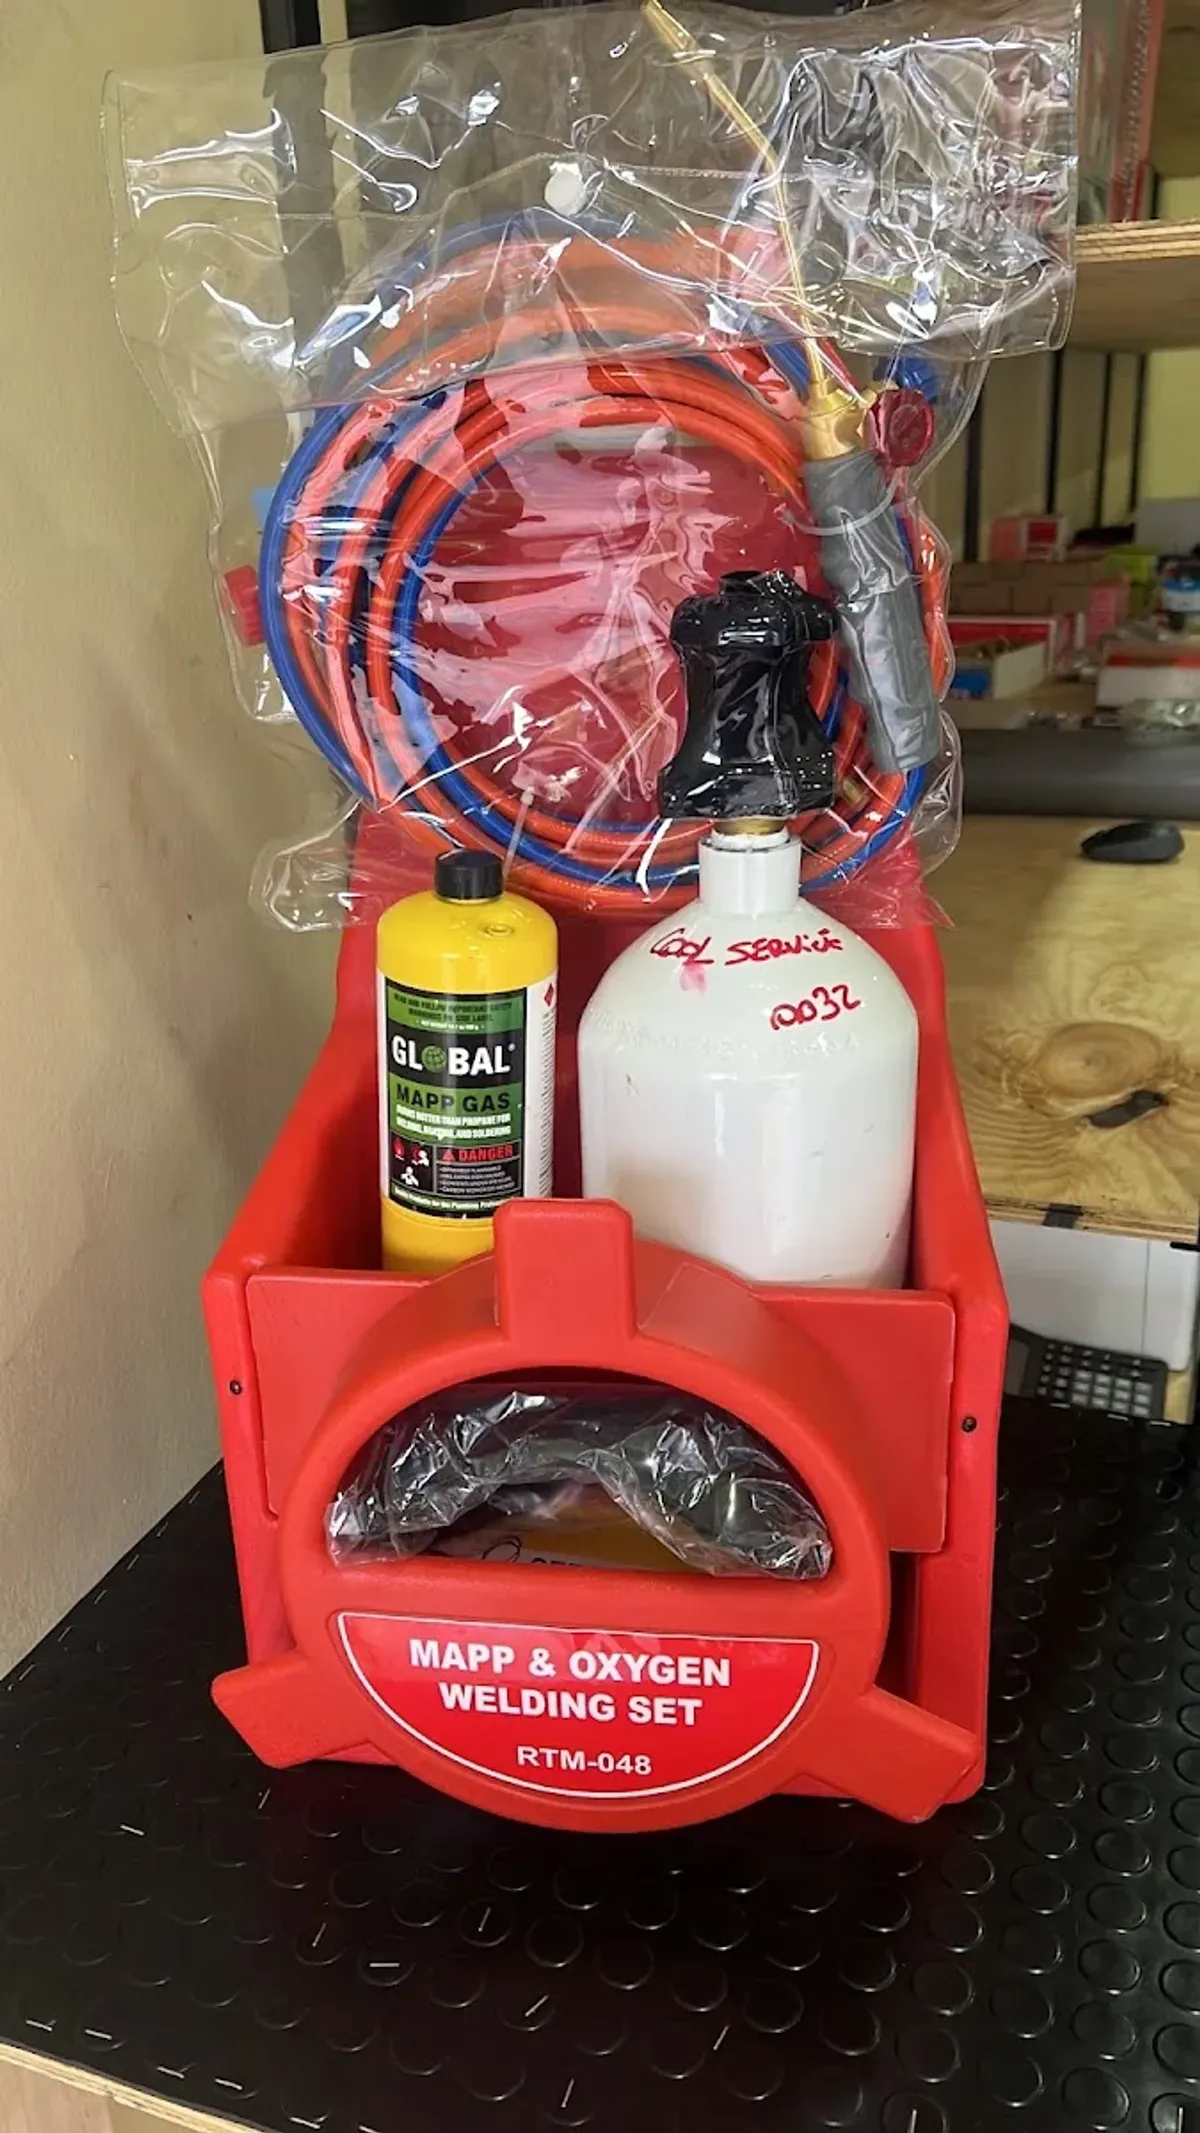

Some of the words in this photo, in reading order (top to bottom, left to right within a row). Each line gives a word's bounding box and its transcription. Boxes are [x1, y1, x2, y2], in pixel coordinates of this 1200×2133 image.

[397, 1083, 455, 1109] MAPP
[463, 1092, 510, 1112] GAS
[459, 1145, 513, 1161] DANGER
[409, 1638, 515, 1674] MAPP
[529, 1649, 556, 1678] &
[568, 1651, 731, 1687] OXYGEN
[438, 1683, 617, 1722] WELDING
[628, 1696, 703, 1727] SET
[516, 1745, 653, 1777] RTM-048
